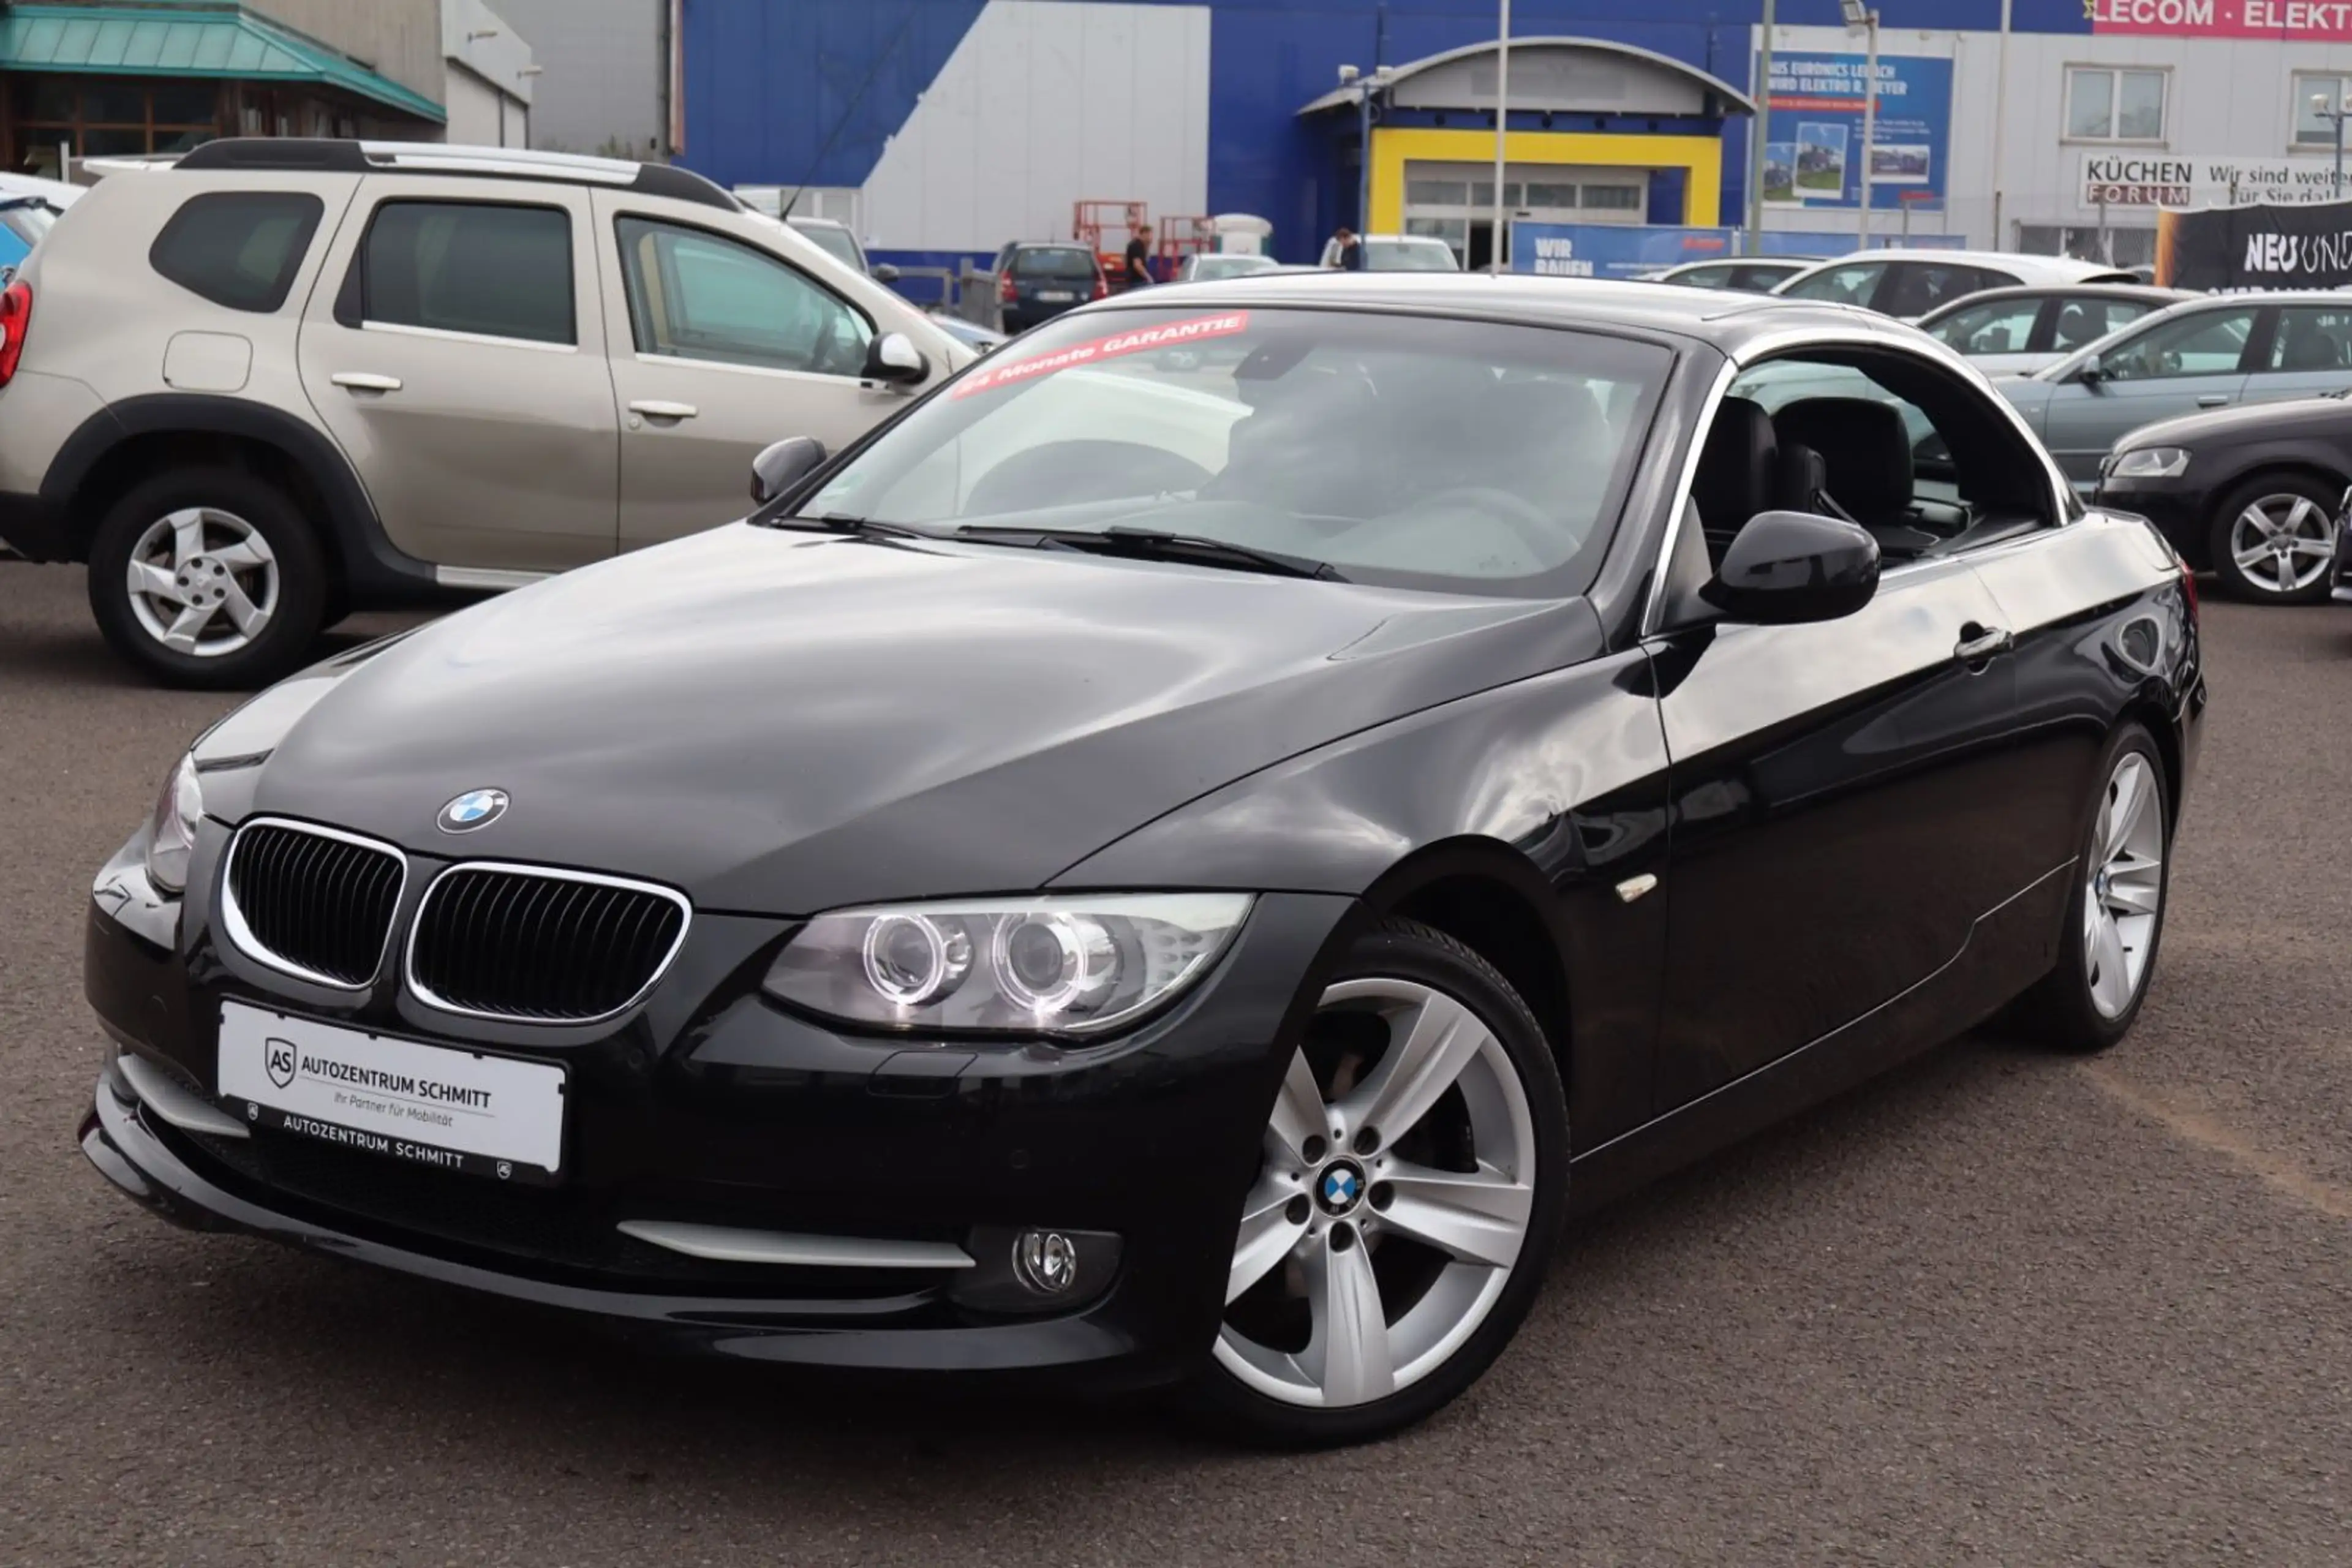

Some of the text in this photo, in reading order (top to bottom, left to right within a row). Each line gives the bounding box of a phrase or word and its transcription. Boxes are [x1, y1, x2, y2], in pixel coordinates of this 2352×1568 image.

[2088, 156, 2352, 185] KÜCHEN Wir sind weite
[2088, 186, 2188, 205] FORUM
[1534, 237, 1572, 258] WIR
[2244, 233, 2299, 273] NEU
[1104, 317, 1241, 352] GARANTIE
[270, 1049, 291, 1073] AS
[301, 1055, 492, 1109] AUTOZENTRUM SCHMITT
[334, 1091, 453, 1127] Ihr Partner für Mobilität
[282, 1114, 465, 1169] AUTOZENTRUM SCHMITT
